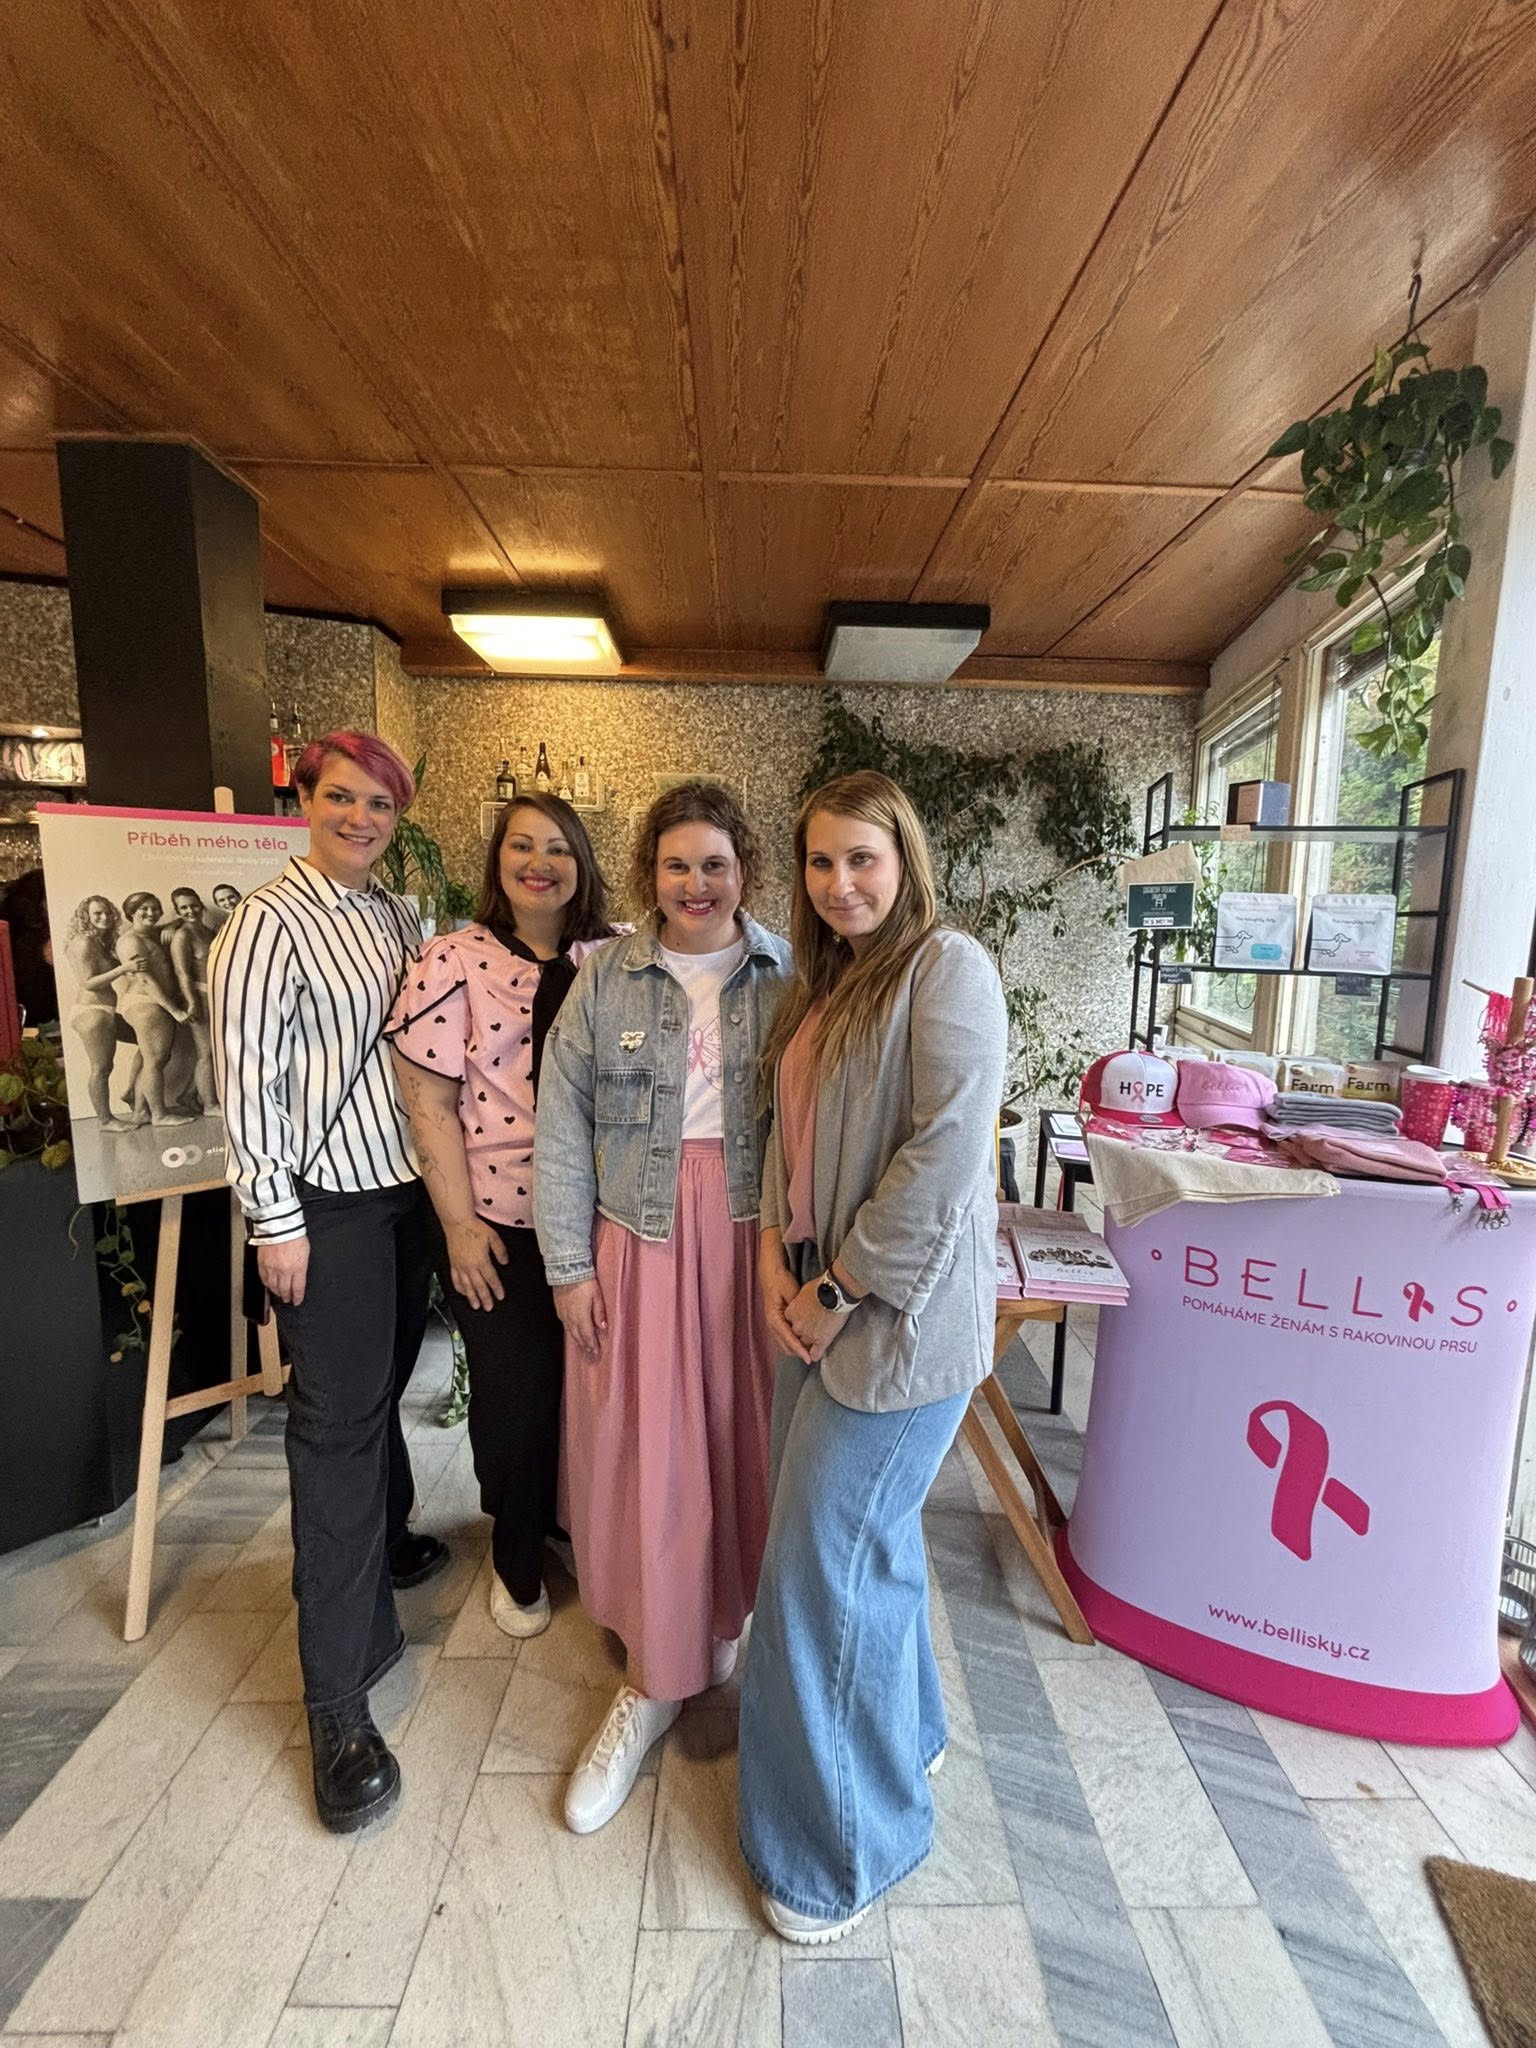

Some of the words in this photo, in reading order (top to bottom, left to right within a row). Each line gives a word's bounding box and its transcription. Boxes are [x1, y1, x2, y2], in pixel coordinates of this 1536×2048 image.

[127, 831, 191, 847] Příběh
[197, 835, 249, 850] mého
[254, 838, 288, 851] těla
[1291, 1078, 1335, 1095] Farm
[1347, 1077, 1391, 1093] Farm
[1182, 1295, 1267, 1326] POMÁHÁME
[1269, 1311, 1325, 1336] ŽENÁM
[1328, 1325, 1338, 1338] S
[1342, 1328, 1435, 1352] RAKOVINOU
[1438, 1340, 1478, 1354] PRSU
[1208, 1603, 1370, 1661] www.bellisky.cz
